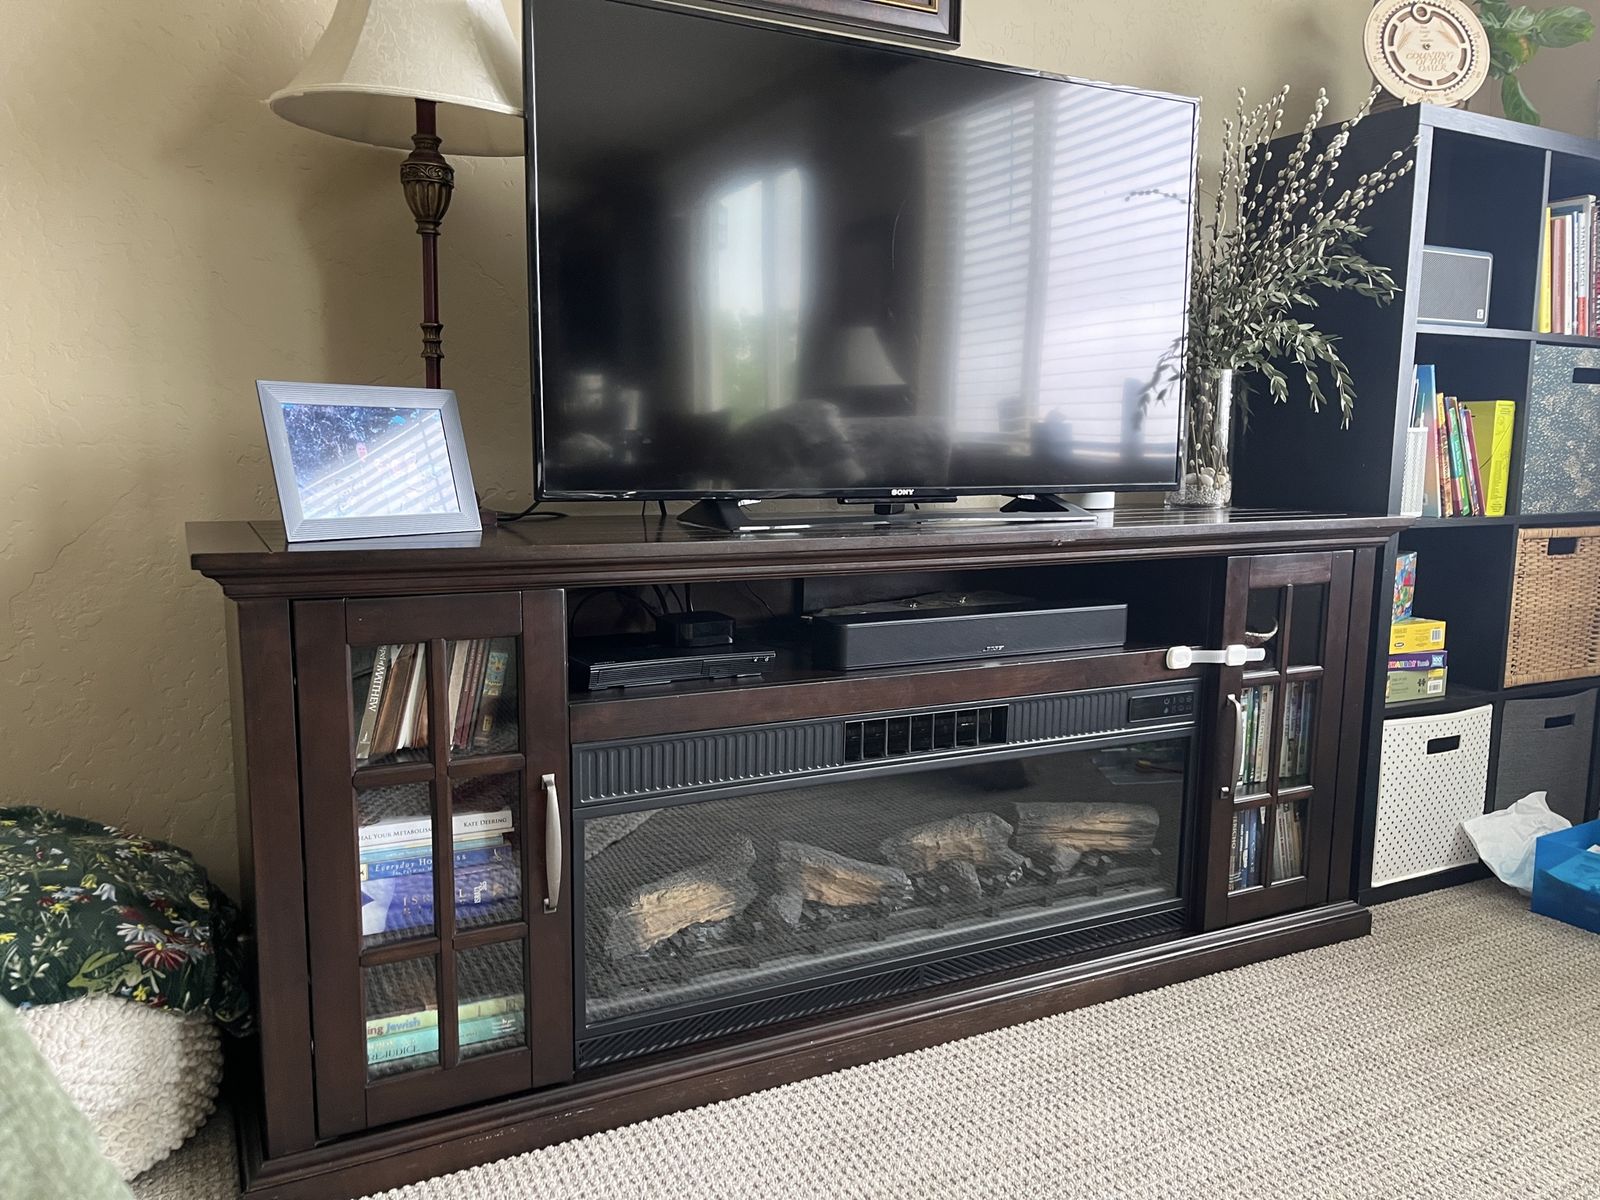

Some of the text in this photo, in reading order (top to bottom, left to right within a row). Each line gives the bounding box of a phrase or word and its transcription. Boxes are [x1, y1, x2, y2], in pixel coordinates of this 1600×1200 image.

[368, 665, 385, 712] MATTHEW
[480, 817, 507, 826] DEERING
[373, 831, 392, 840] YOUR
[375, 860, 415, 873] Everyday
[385, 1017, 421, 1034] Jewish
[368, 1044, 420, 1060] REJUDICE
